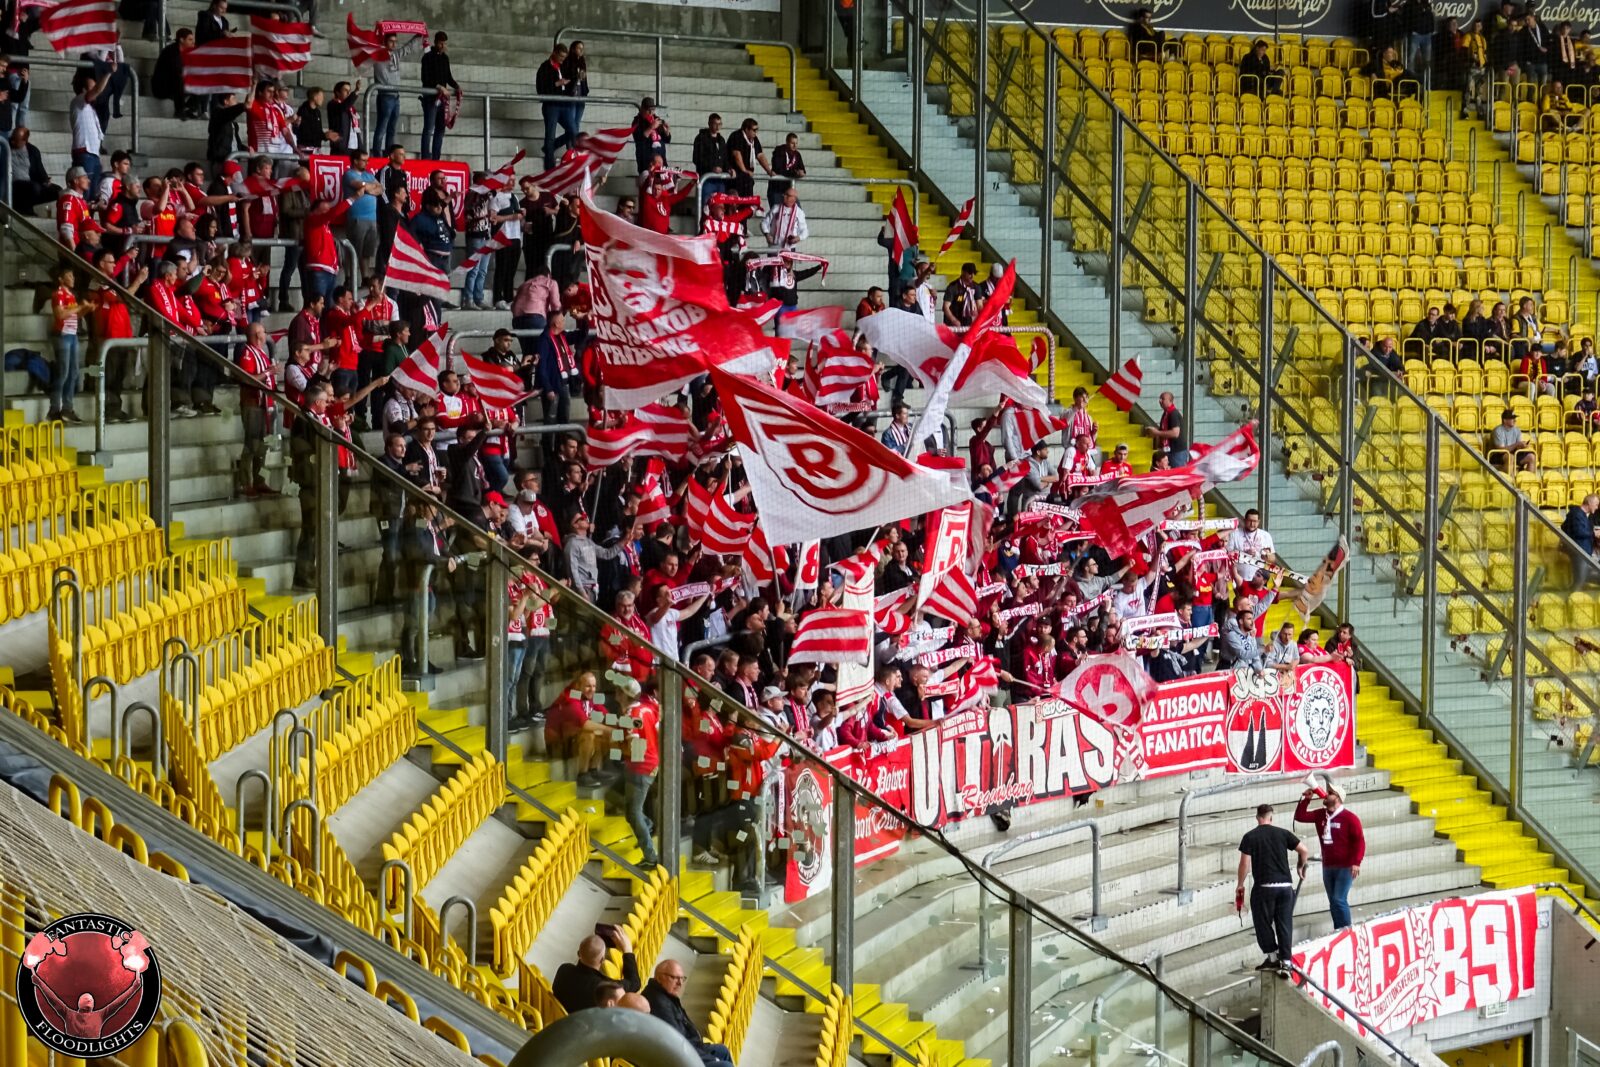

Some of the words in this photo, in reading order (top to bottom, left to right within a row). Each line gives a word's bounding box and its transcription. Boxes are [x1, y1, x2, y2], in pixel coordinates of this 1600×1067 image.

[1145, 724, 1226, 757] FANATICA
[912, 705, 1115, 828] ULTRAS
[961, 773, 1035, 813] Regensburg
